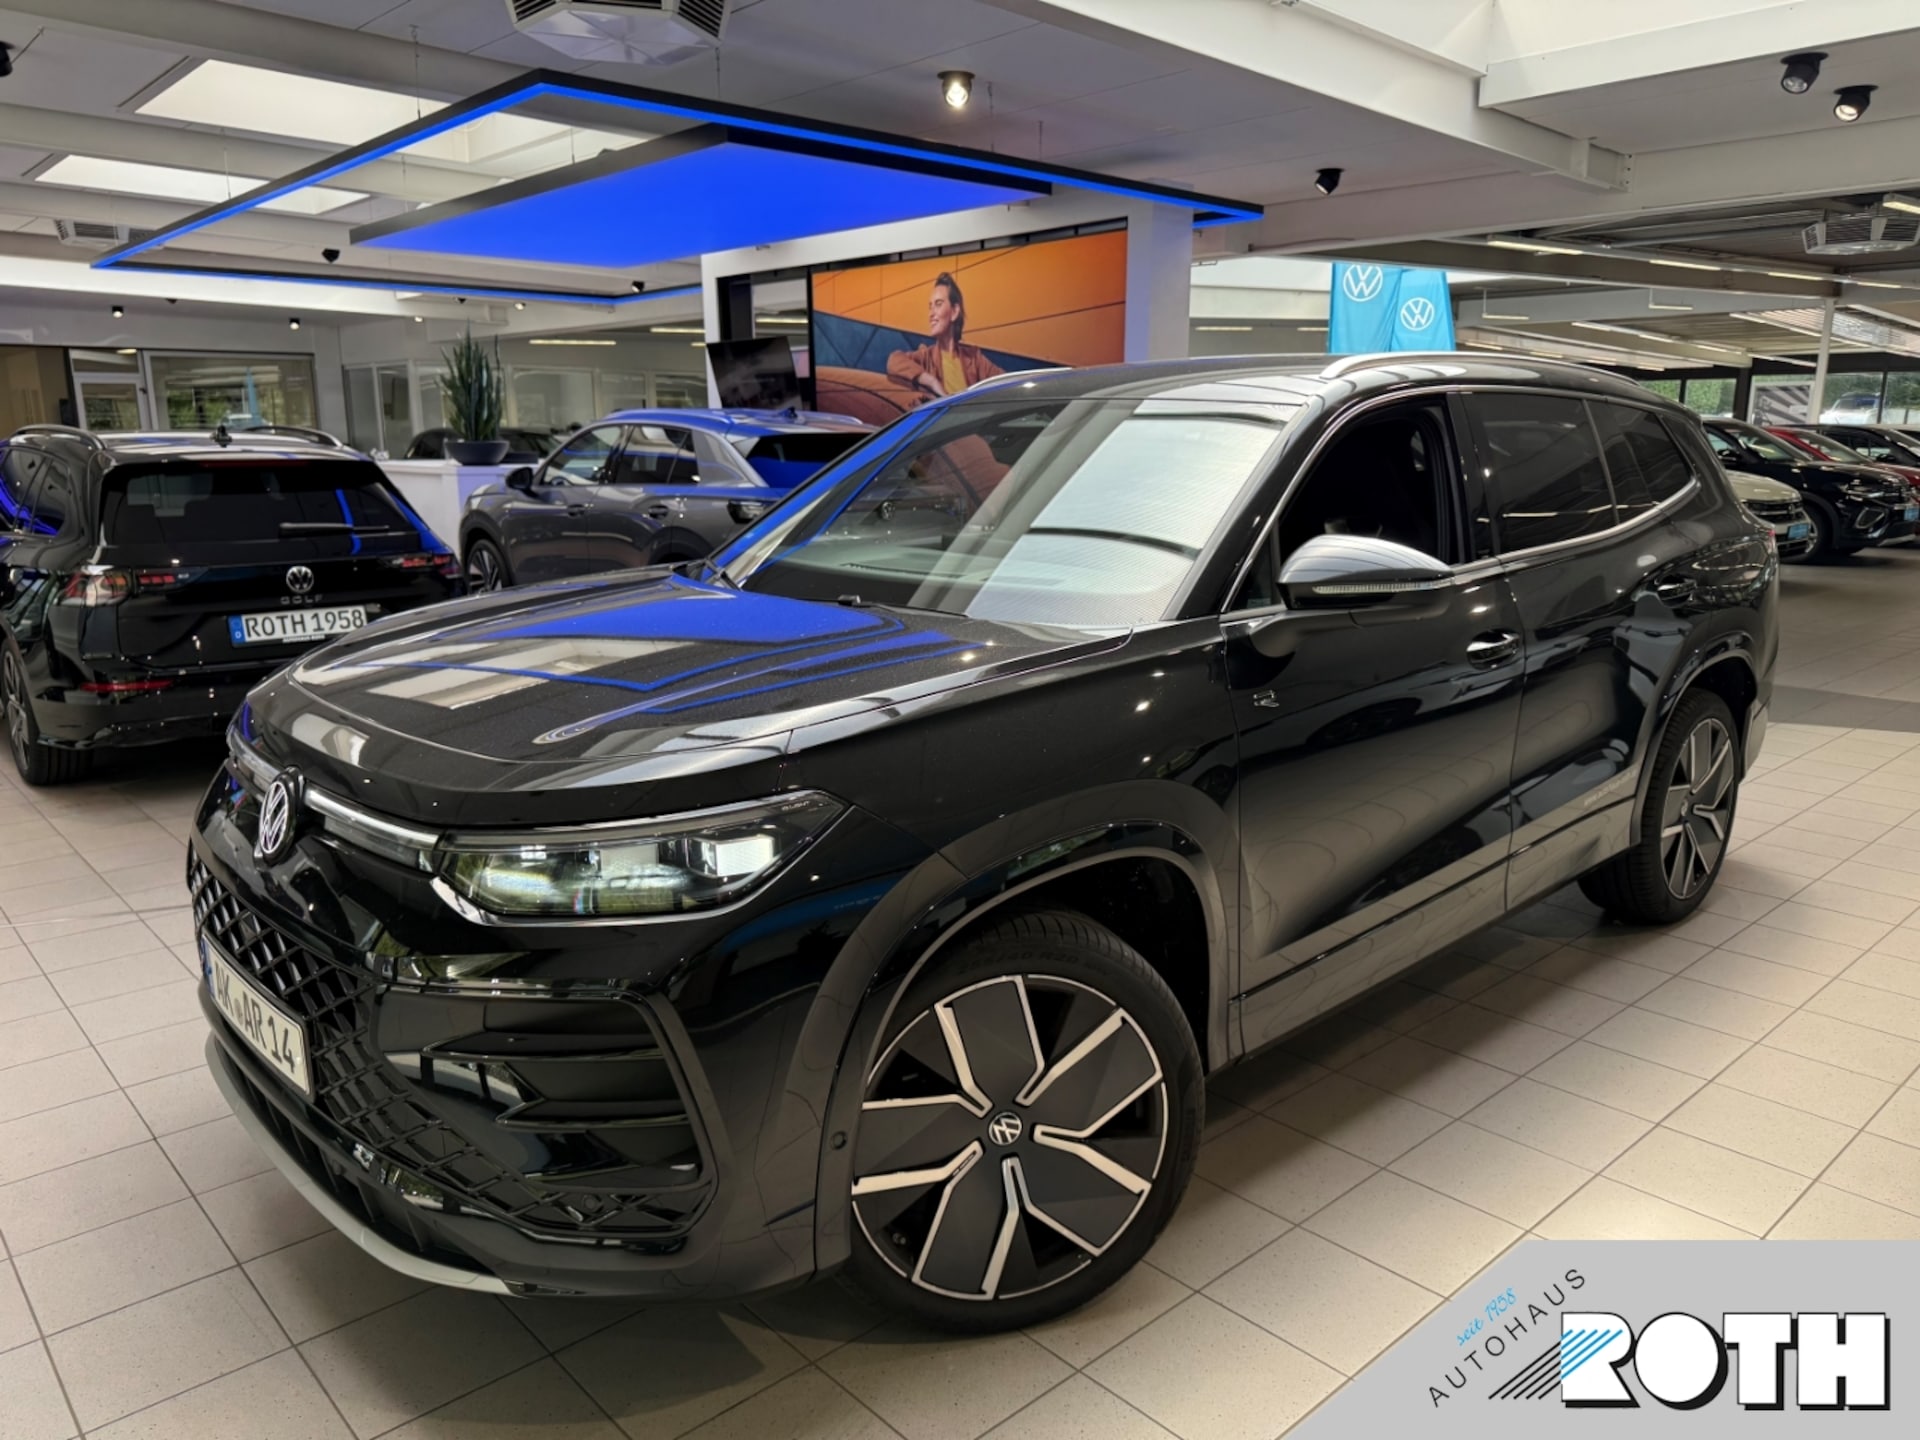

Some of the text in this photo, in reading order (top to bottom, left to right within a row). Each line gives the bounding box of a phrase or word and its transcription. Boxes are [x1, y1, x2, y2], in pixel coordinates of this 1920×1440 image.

[1401, 297, 1434, 331] VW
[280, 594, 323, 605] GOLF
[245, 609, 365, 639] ROTH 1958
[243, 990, 268, 1050] AR
[268, 1015, 295, 1075] 14
